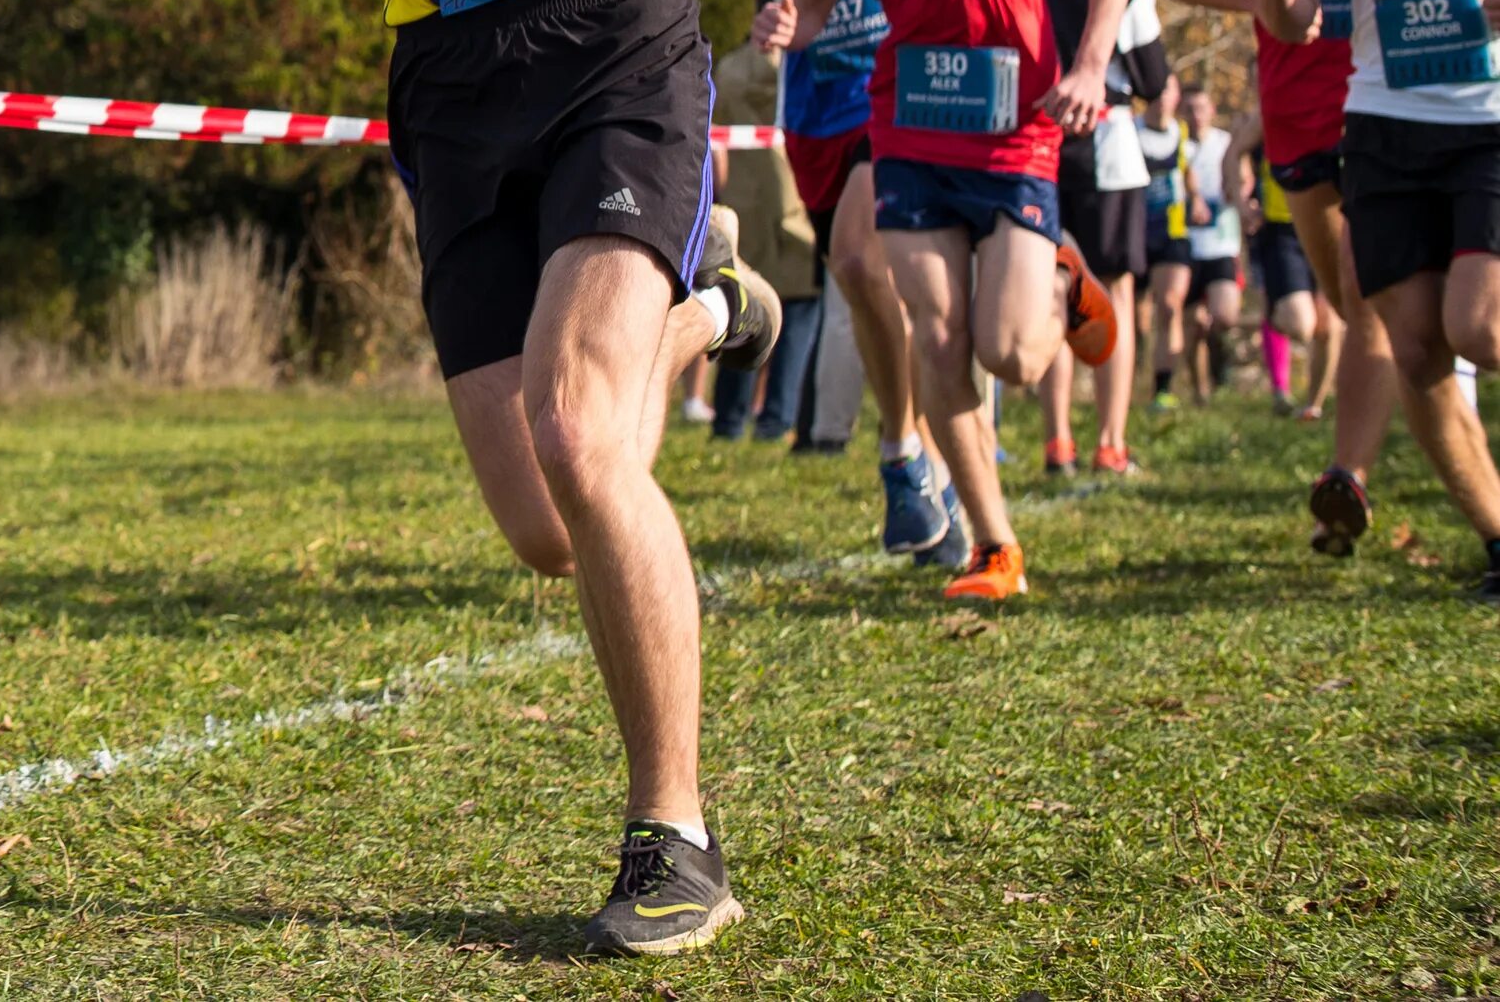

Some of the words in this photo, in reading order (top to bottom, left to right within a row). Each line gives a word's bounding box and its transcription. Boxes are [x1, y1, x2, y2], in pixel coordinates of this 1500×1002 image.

[1400, 22, 1462, 42] CONNOR
[924, 51, 969, 76] 330
[930, 76, 961, 92] ALEX
[598, 200, 641, 216] adidas
